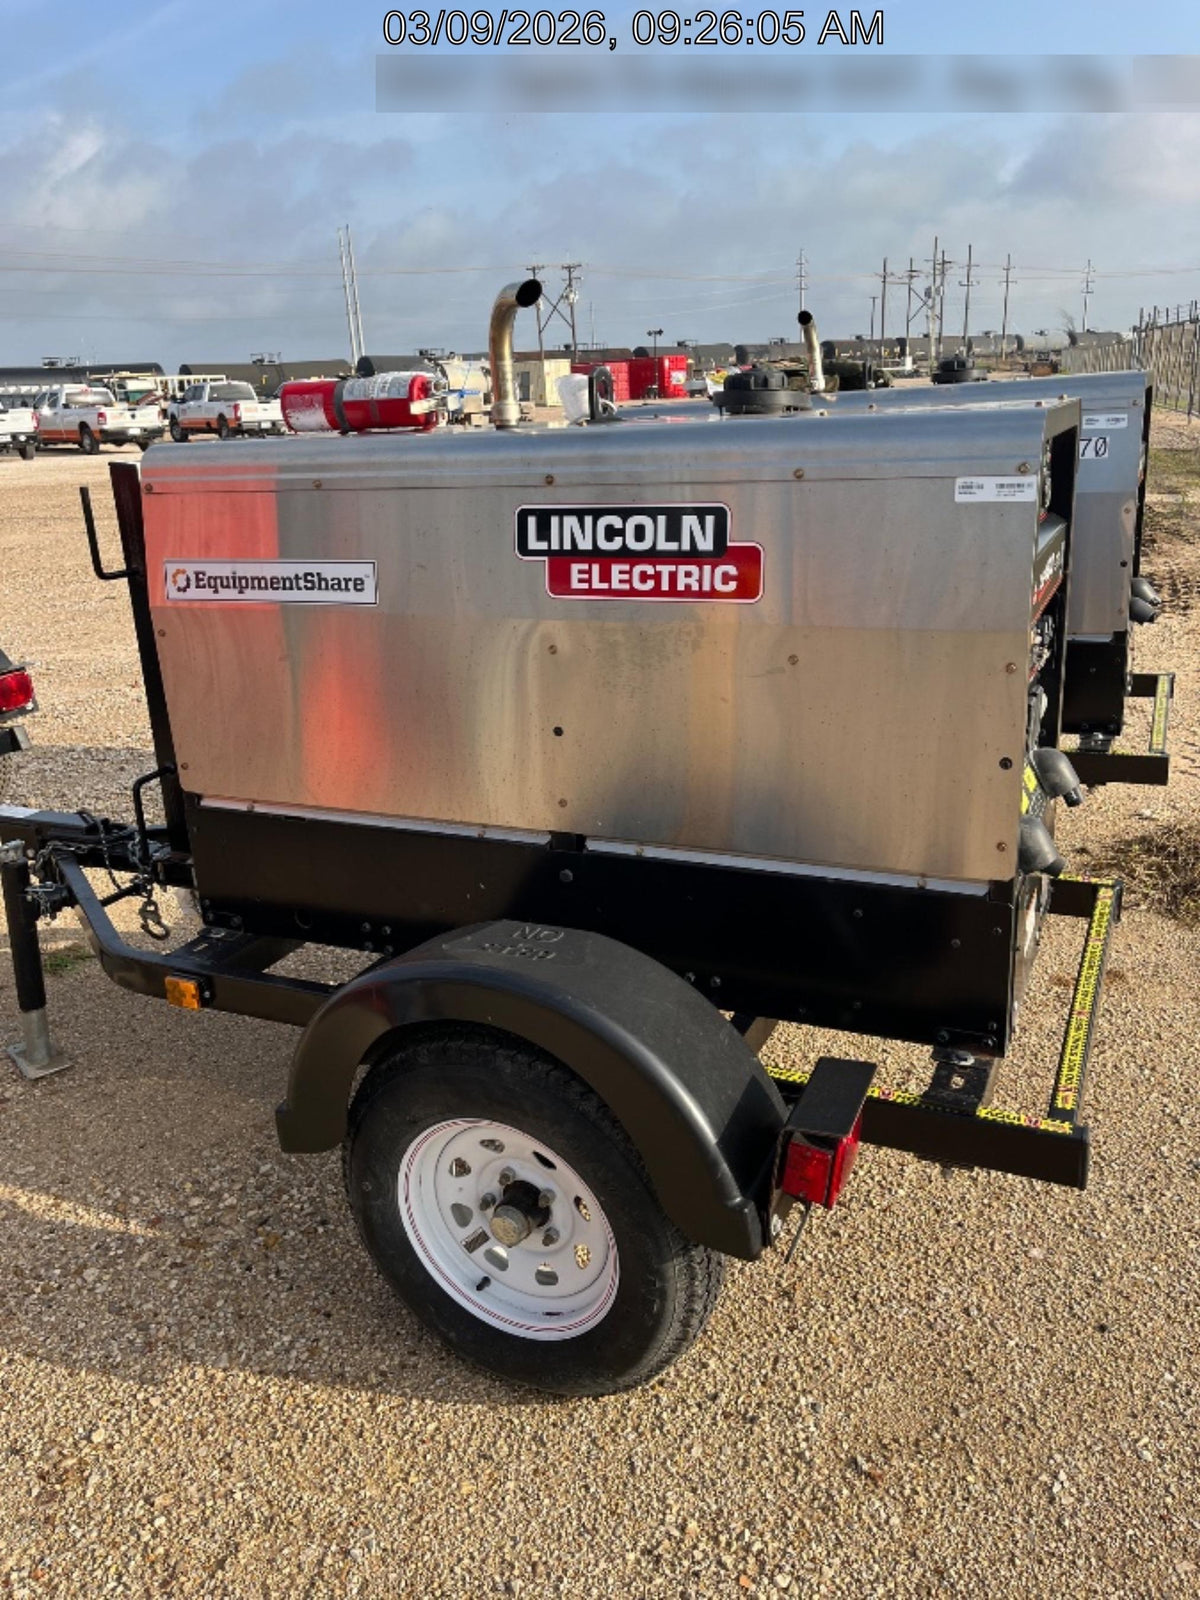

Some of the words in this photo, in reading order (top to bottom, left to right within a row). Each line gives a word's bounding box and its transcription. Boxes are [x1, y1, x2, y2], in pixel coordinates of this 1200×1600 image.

[527, 514, 715, 551] LINCOLN
[193, 570, 365, 594] EquipmentShare
[570, 563, 738, 592] ELECTRIC
[512, 926, 565, 943] NO
